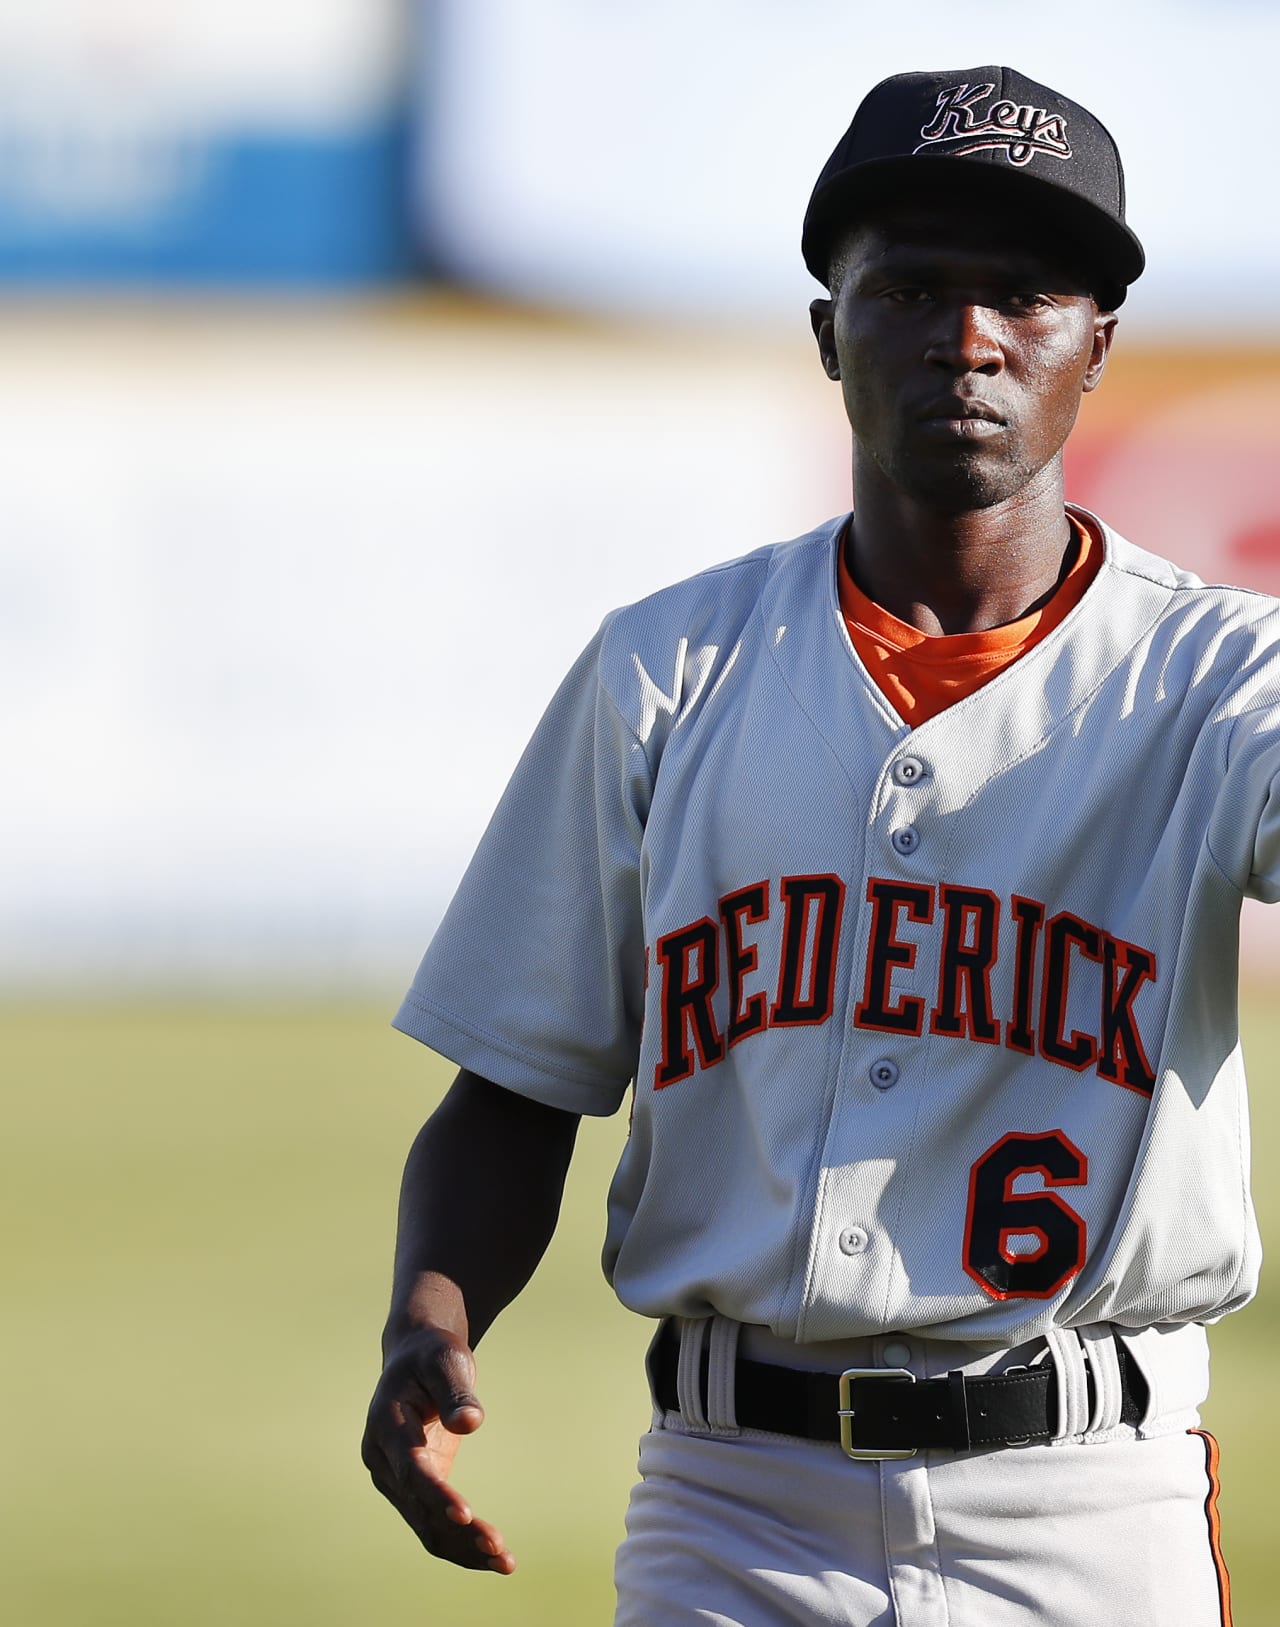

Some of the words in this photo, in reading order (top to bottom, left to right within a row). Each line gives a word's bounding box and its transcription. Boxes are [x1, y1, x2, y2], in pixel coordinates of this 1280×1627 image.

[916, 83, 1073, 167] Keys
[644, 872, 1157, 1099] REDERICK
[962, 1128, 1088, 1300] 6
